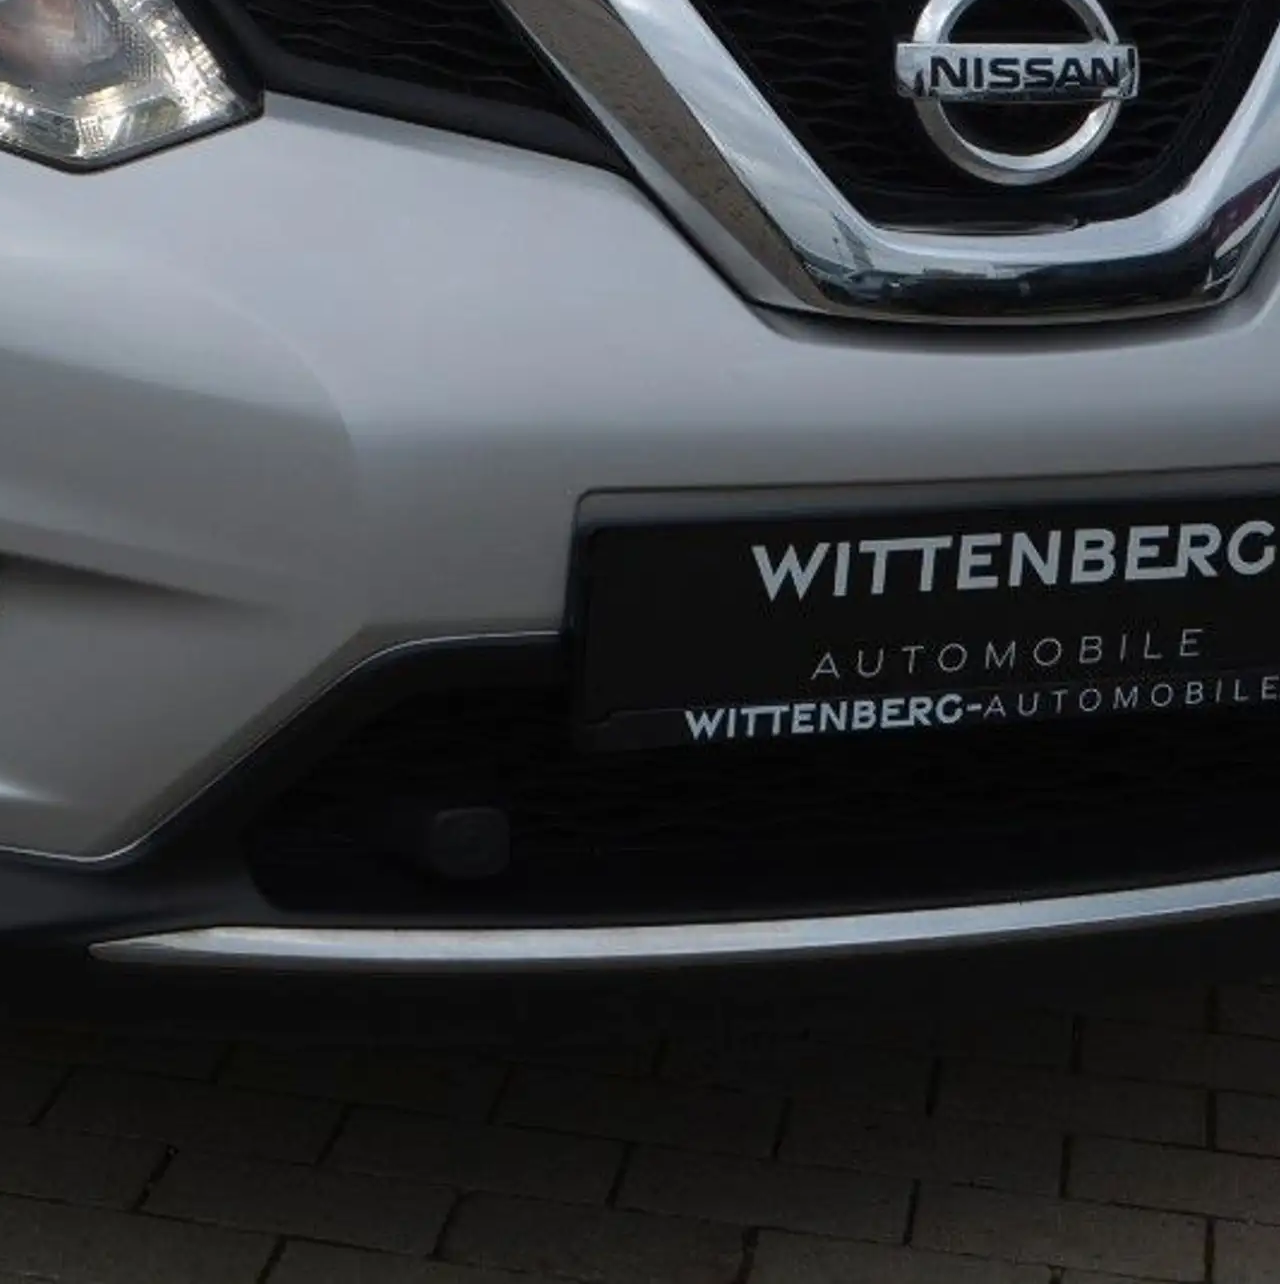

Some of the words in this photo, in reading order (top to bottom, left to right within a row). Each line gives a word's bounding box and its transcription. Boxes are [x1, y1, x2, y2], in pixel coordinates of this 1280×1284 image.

[930, 55, 1120, 89] NISSAN
[752, 520, 1277, 603] WITTENBERG
[812, 628, 1206, 681] AUTOMOBILE
